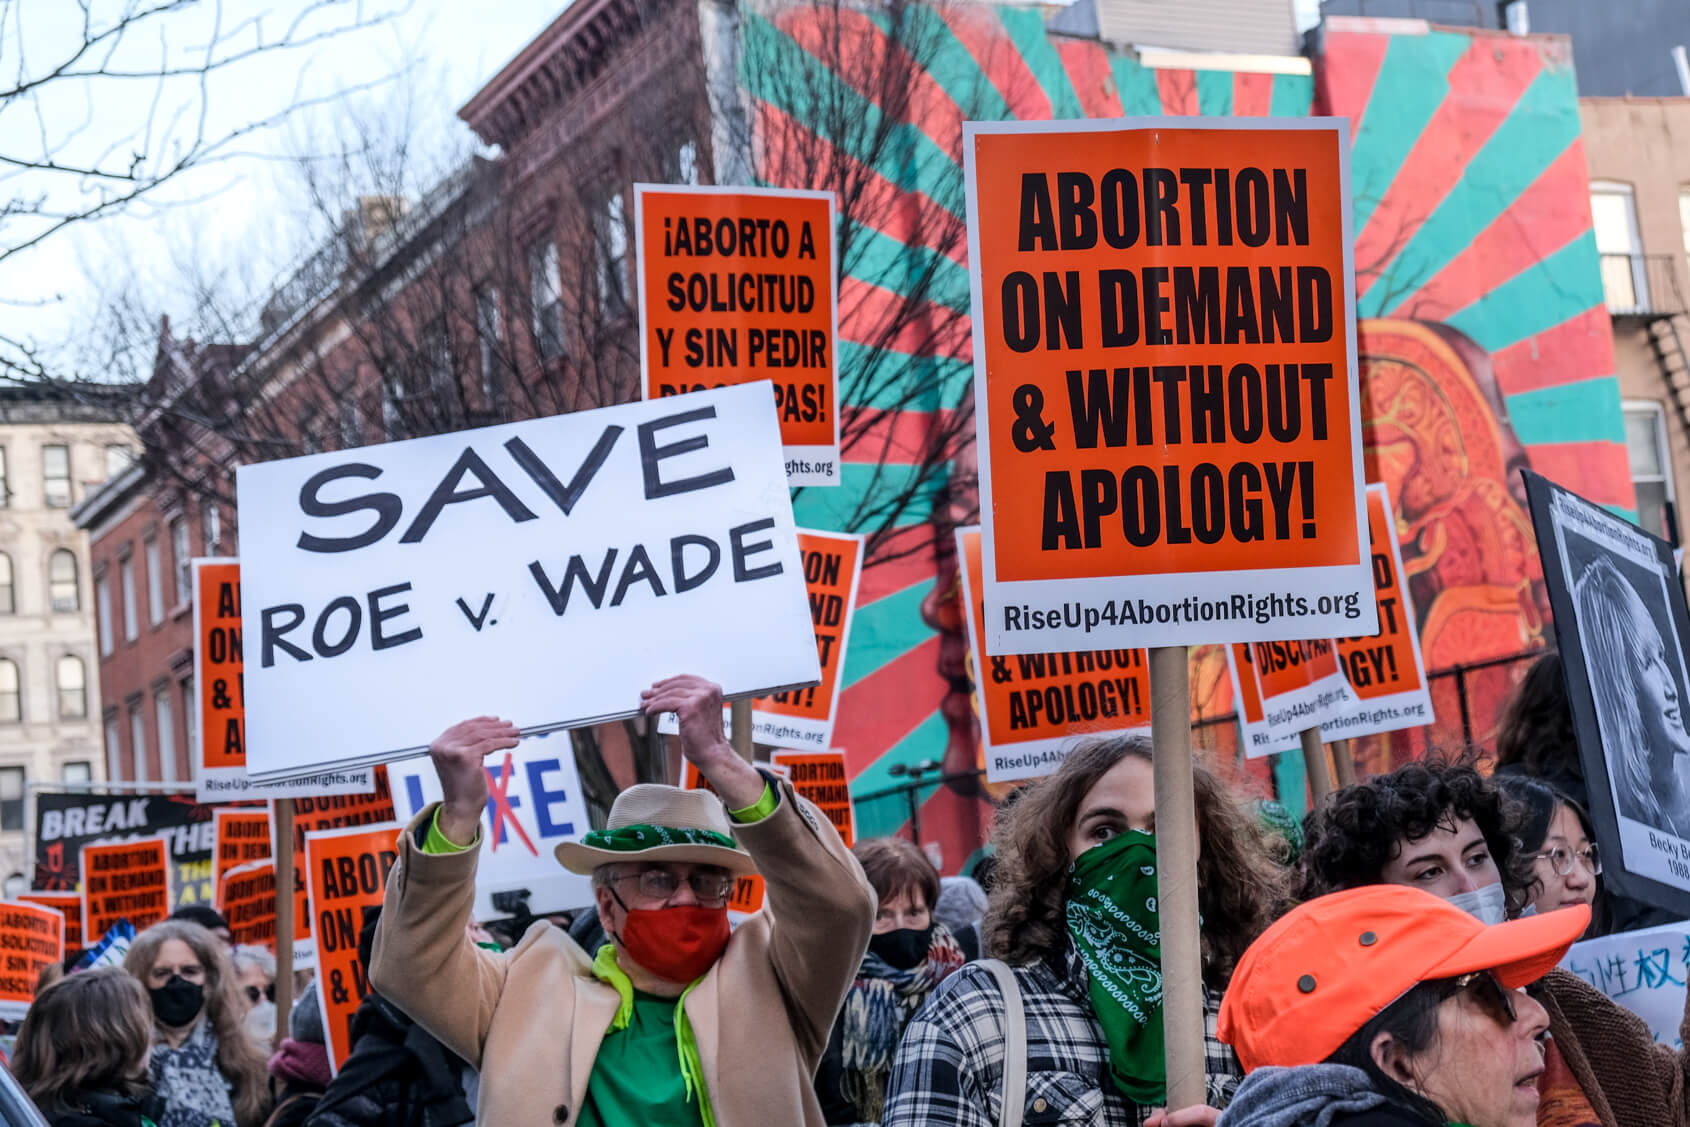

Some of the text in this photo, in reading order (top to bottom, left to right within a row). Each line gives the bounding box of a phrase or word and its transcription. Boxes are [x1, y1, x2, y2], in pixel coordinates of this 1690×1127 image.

[1018, 167, 1310, 252] ABORTION
[664, 217, 816, 260] ¡ABORTO A
[667, 272, 814, 313] SOLICITUD
[1001, 266, 1333, 352] ON DEMAND
[656, 328, 826, 368] Y SIN PEDIR
[1011, 363, 1333, 453] & WITHOUT
[296, 405, 735, 553] SAVE
[1041, 461, 1317, 551] APOLOGY!
[260, 581, 423, 668] ROE
[528, 517, 783, 616] WADE
[1003, 592, 1361, 632] RiseUp4AbortionRights.org
[991, 655, 1012, 684] &
[212, 679, 231, 709] &
[1010, 677, 1142, 731] APOLOGY!
[789, 762, 845, 781] BORTION
[40, 798, 150, 841] BREAK
[1649, 832, 1679, 860] Becky
[321, 908, 356, 952] ON
[330, 969, 349, 1005] &
